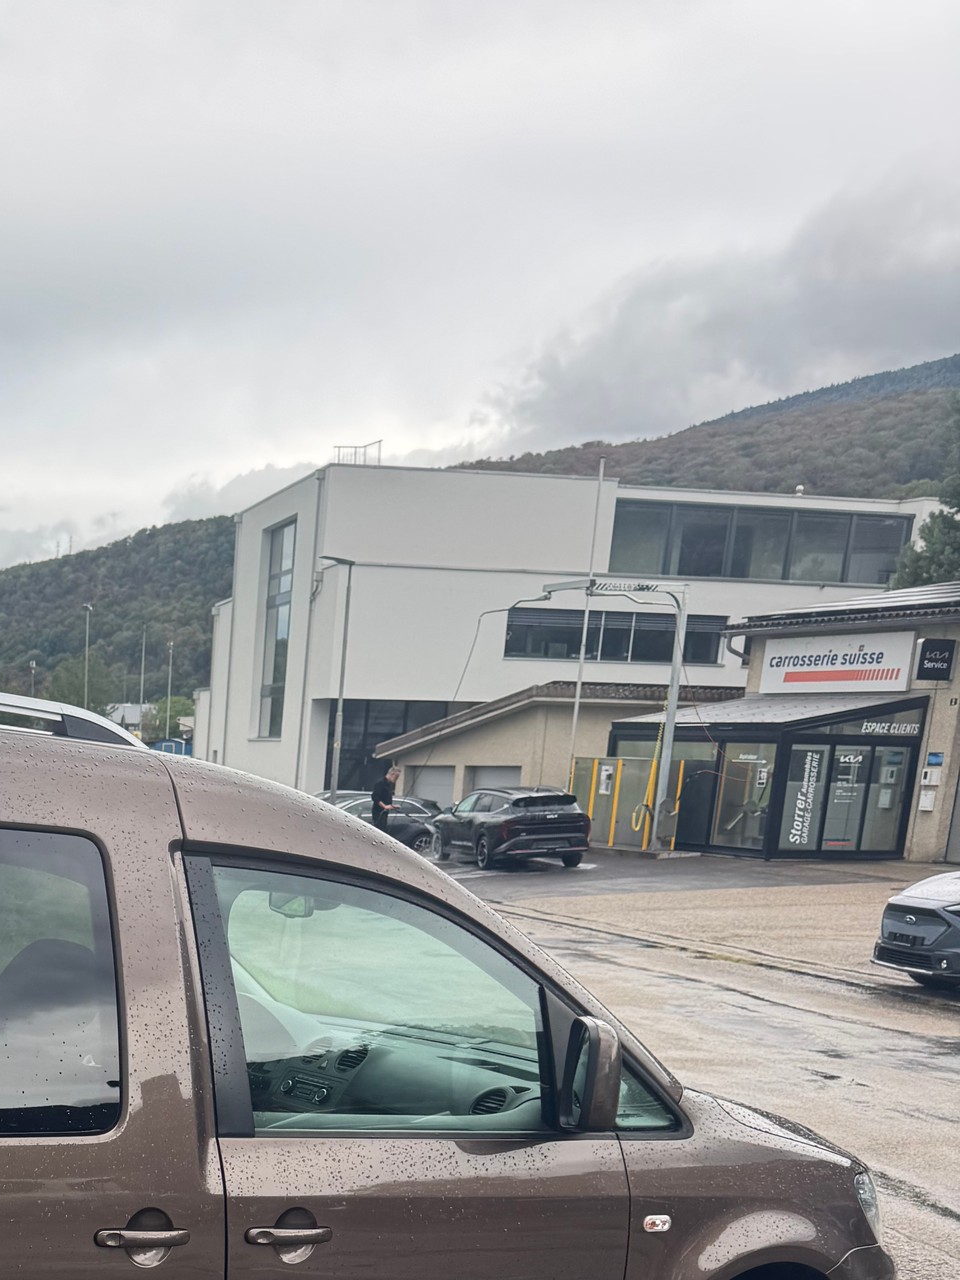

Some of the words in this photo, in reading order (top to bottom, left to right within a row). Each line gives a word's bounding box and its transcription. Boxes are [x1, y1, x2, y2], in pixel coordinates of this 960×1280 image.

[769, 649, 838, 668] carrosserie
[840, 645, 884, 666] suisse
[923, 660, 948, 670] Service
[861, 722, 891, 733] ESPACE
[890, 723, 920, 735] CLIENTS
[839, 754, 863, 763] KIA
[789, 792, 806, 844] Storrer
[801, 751, 813, 793] Automobiles
